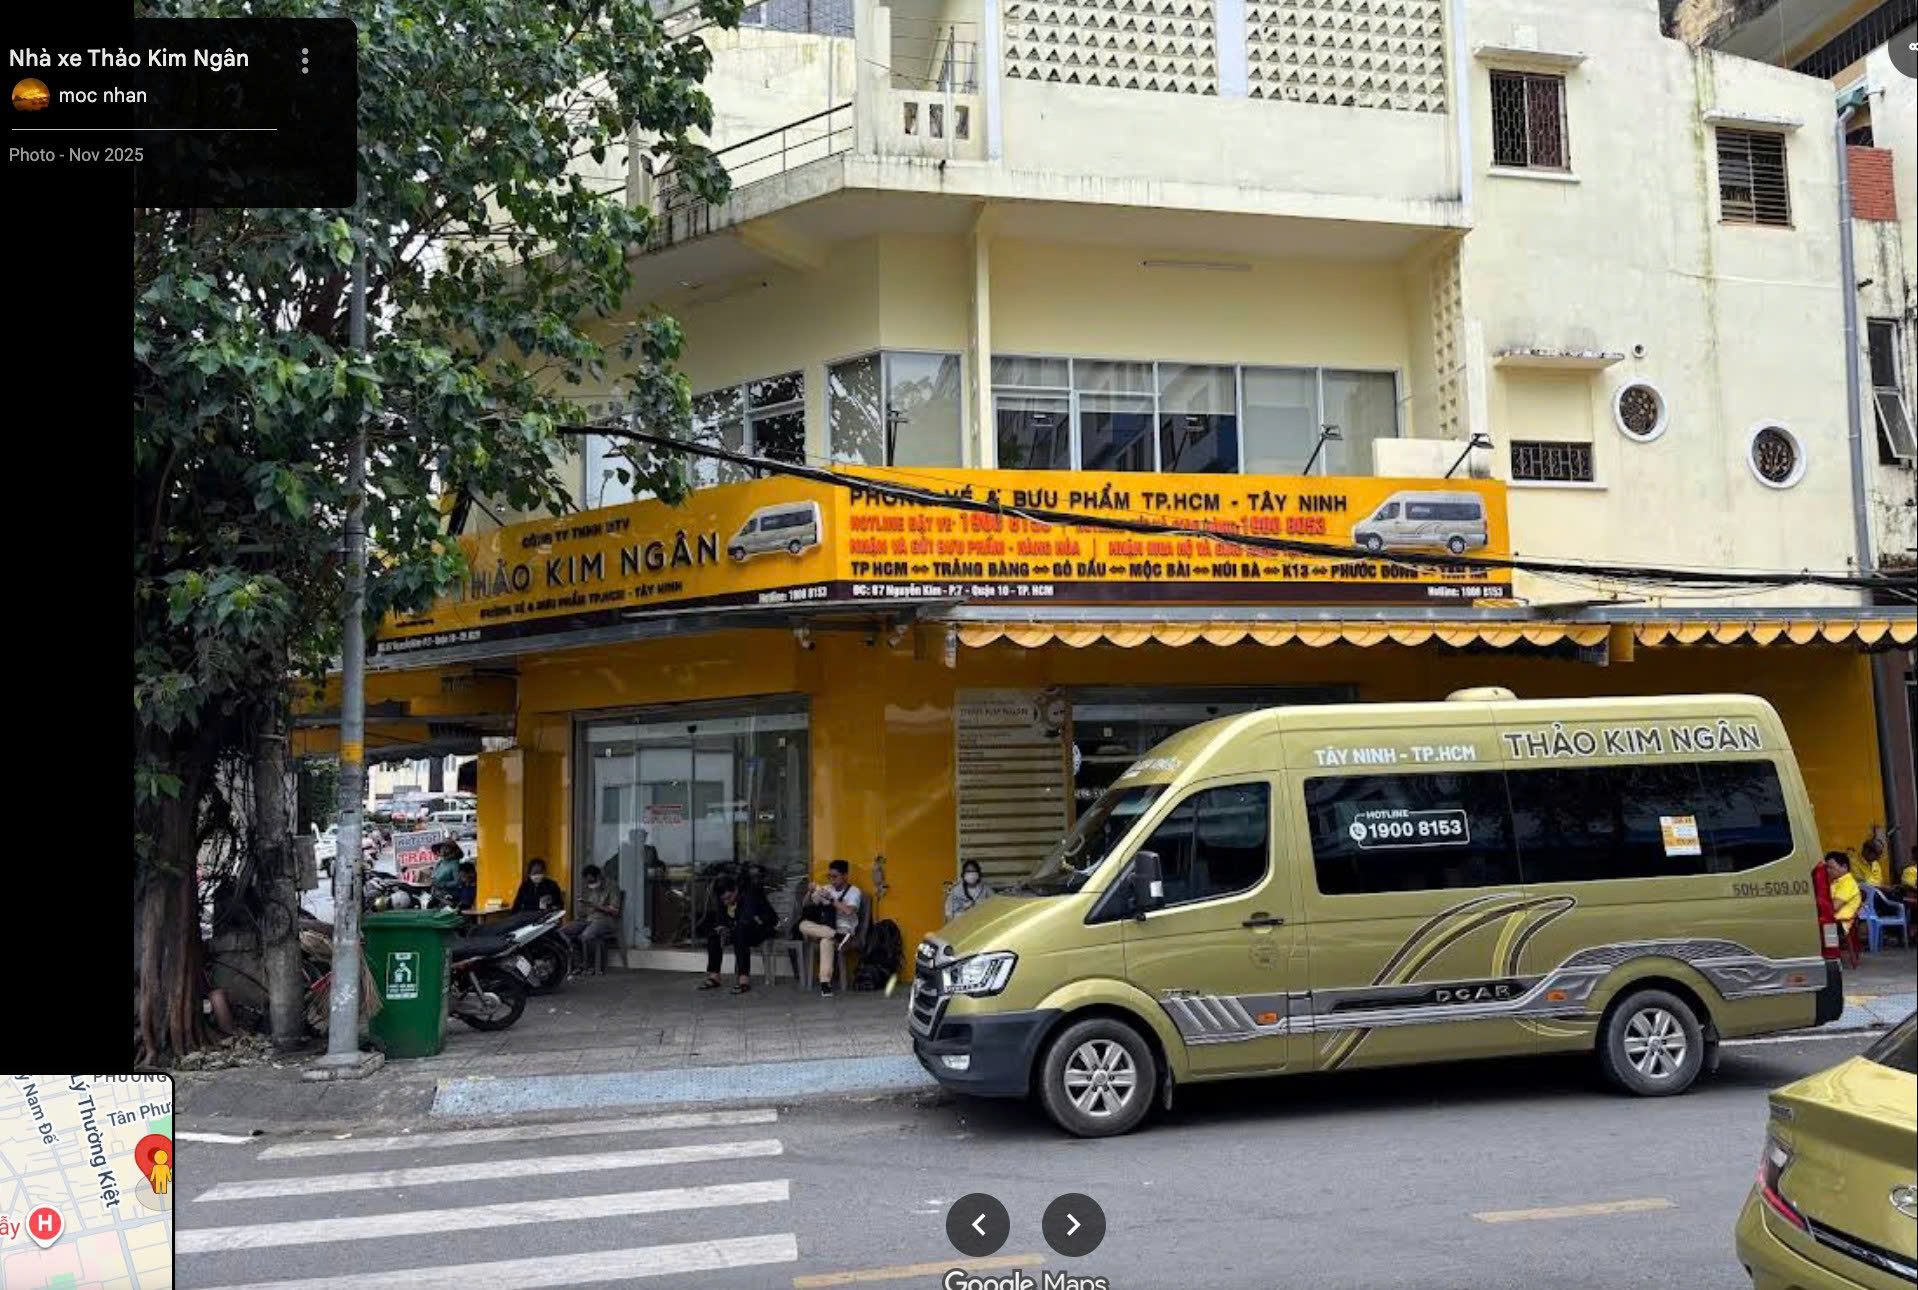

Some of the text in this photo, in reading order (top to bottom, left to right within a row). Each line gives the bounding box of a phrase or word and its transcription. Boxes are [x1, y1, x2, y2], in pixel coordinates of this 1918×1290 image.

[1013, 488, 1058, 508] BƯU
[1069, 483, 1130, 509] PHẨM
[1142, 492, 1220, 511] TP.HCM
[1248, 490, 1287, 512] TÂY
[1299, 495, 1347, 513] NINH
[546, 551, 606, 588] KIM
[620, 529, 719, 576] NGÂN
[873, 561, 908, 576] HCM
[1282, 563, 1309, 579] K13
[923, 584, 942, 596] Kim
[1032, 585, 1054, 596] HCM
[1504, 720, 1762, 760] THẢO KIM NGÂN
[1314, 745, 1348, 765] TÂY
[1352, 748, 1396, 764] NINH
[1411, 745, 1476, 762] TP.HCM
[1366, 810, 1409, 819] HOTLINE
[1368, 820, 1462, 838] 1900 8153
[1436, 985, 1510, 1002] DCAR
